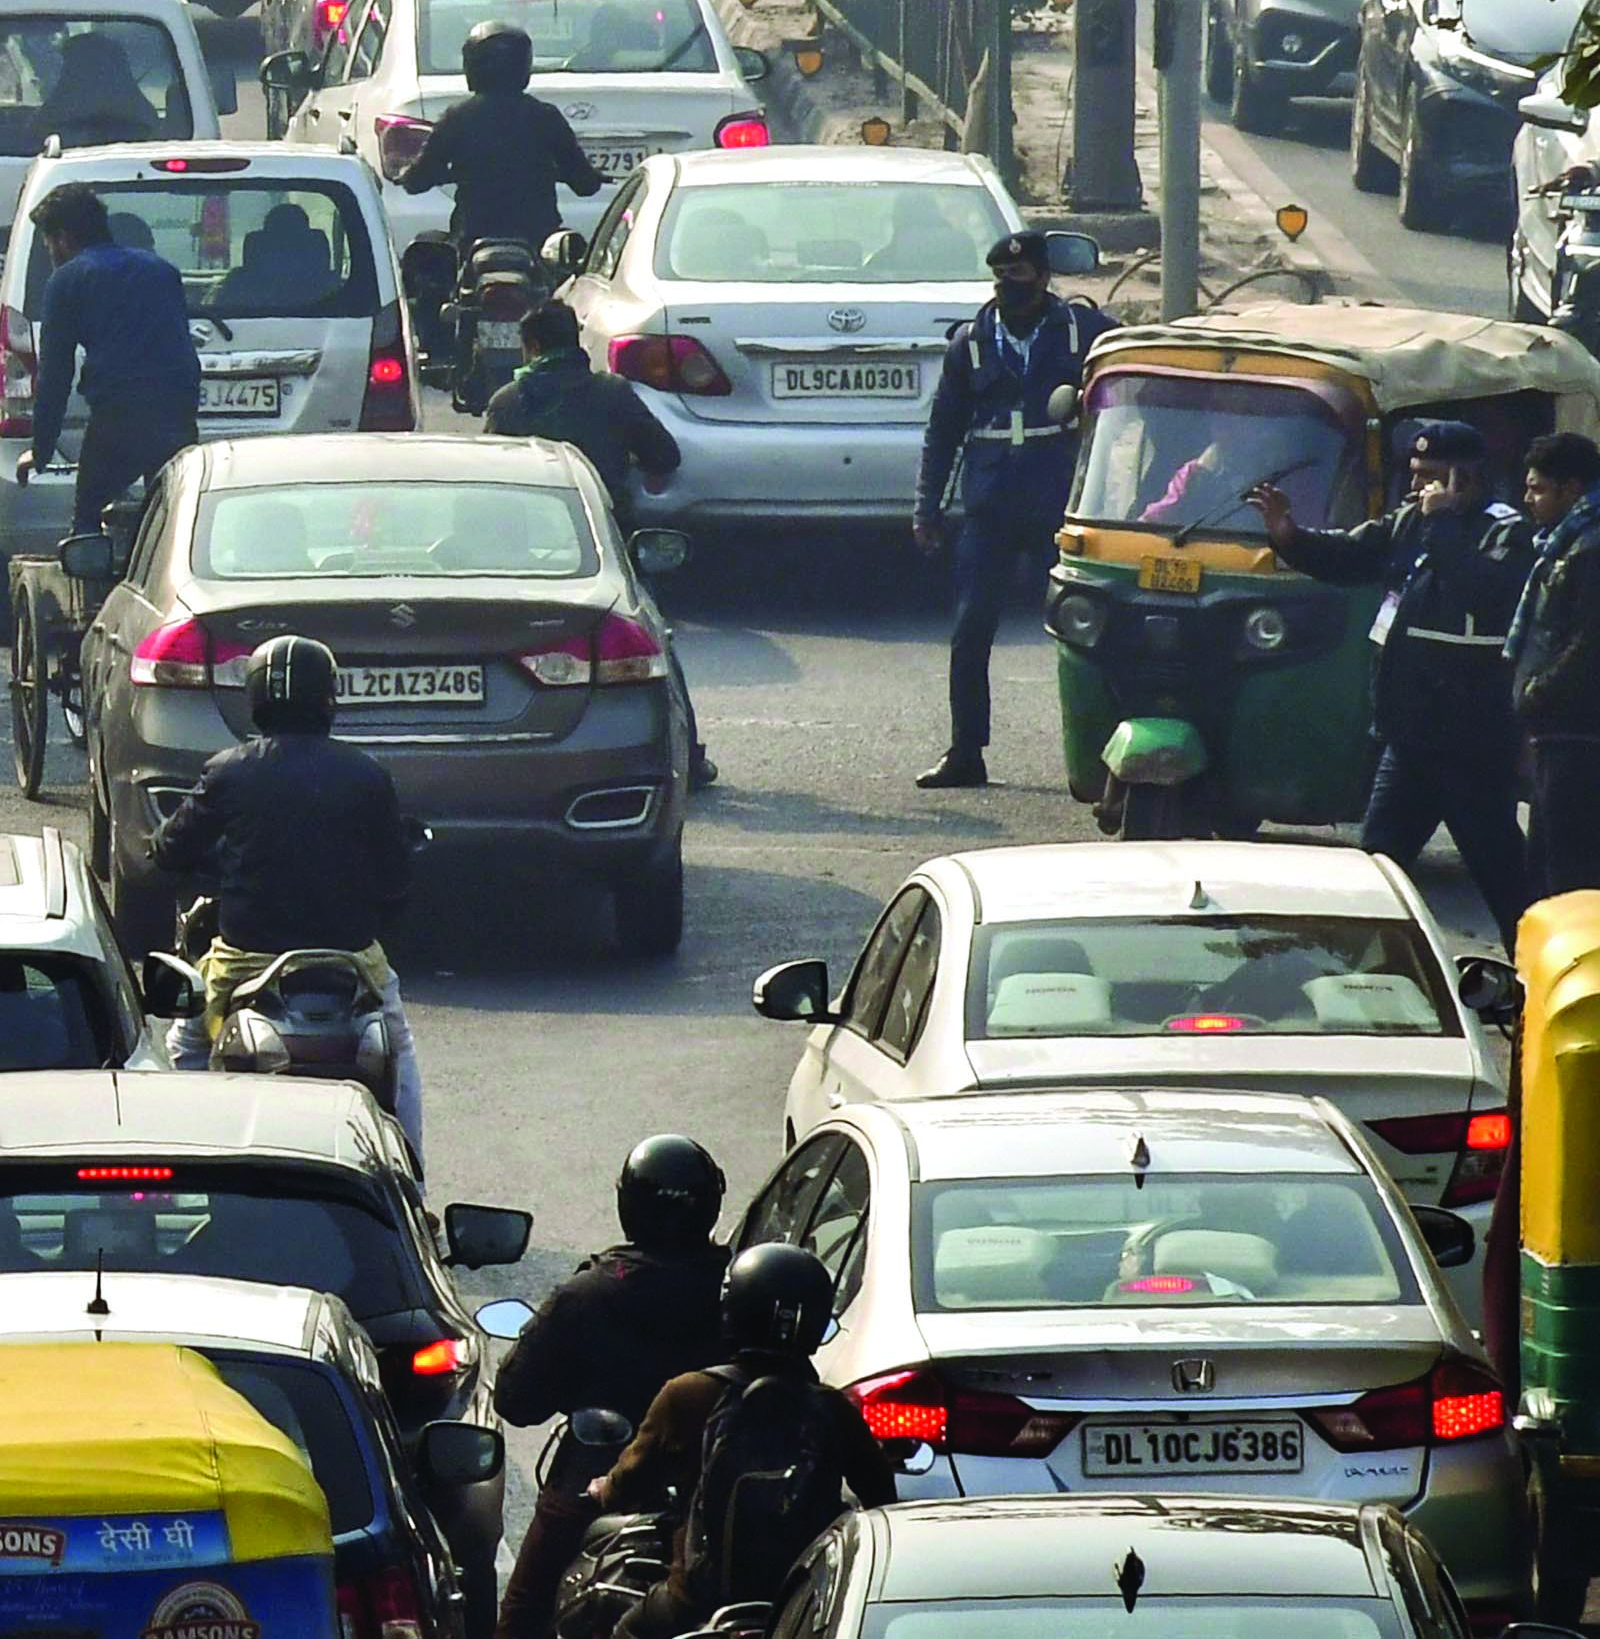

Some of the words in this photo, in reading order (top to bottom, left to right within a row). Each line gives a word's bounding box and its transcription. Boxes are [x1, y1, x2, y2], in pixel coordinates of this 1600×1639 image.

[786, 369, 915, 392] DL9CAA0301
[1103, 1430, 1298, 1465] DL10CJ6386
[96, 1518, 152, 1554] देसी
[161, 1518, 195, 1550] घी
